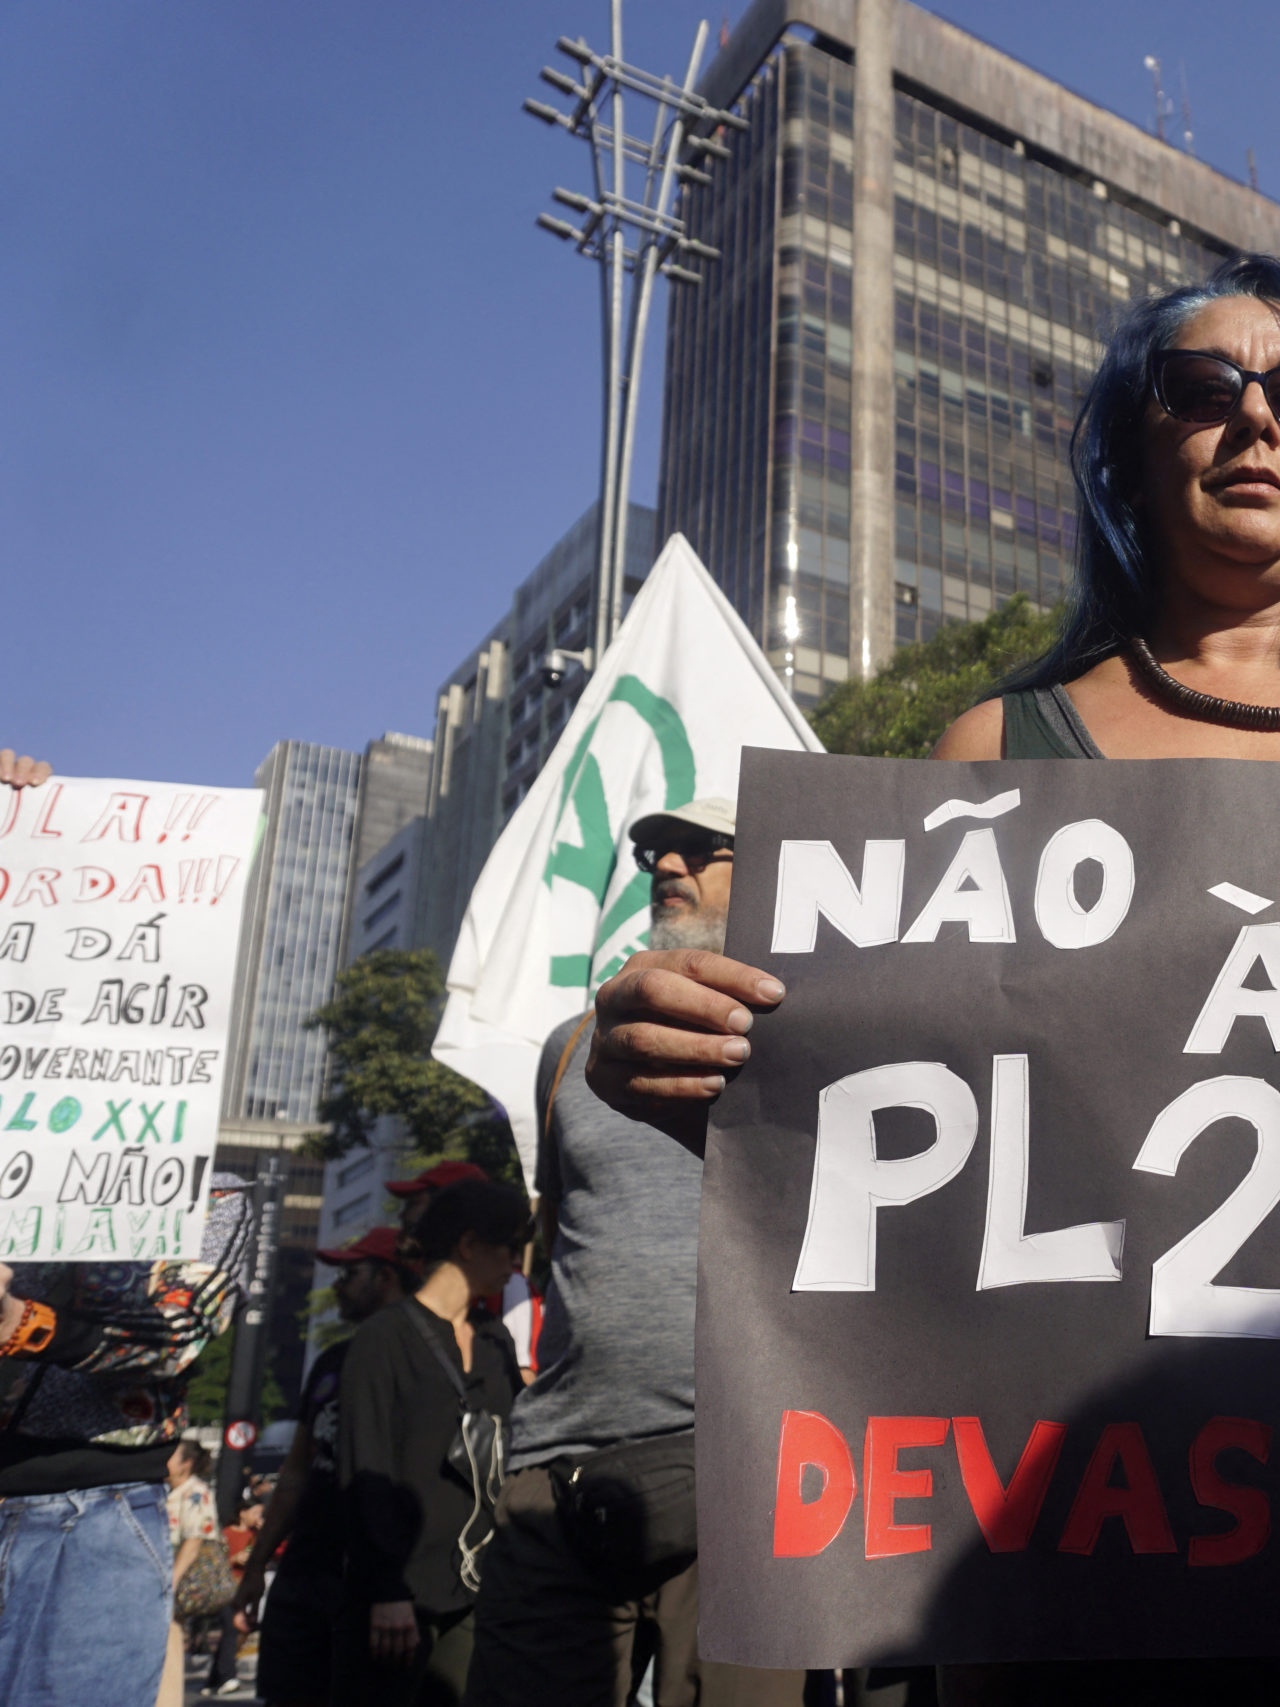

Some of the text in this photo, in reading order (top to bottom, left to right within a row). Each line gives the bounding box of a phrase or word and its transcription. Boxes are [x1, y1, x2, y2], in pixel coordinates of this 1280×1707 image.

[0, 854, 241, 906] RDA!!!
[770, 788, 1136, 953] NÃO
[64, 911, 168, 964] DÁ
[2, 987, 67, 1026] DE
[91, 1098, 188, 1143] XXI
[56, 1145, 210, 1215] NÃO!
[248, 1201, 279, 1295] Pamplona
